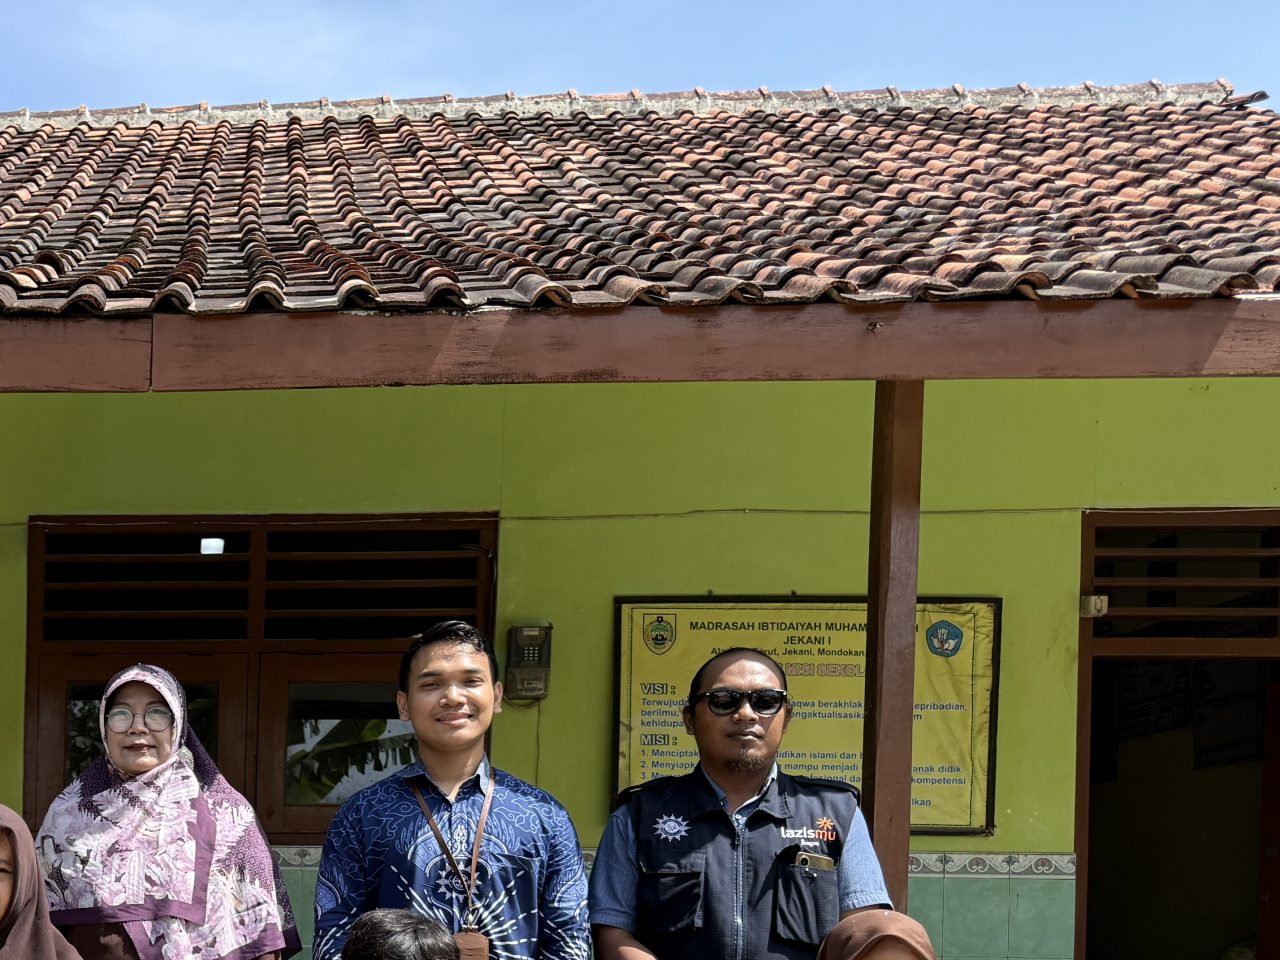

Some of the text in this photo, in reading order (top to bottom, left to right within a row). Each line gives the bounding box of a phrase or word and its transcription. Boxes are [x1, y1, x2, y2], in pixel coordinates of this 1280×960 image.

[689, 621, 867, 632] MADRASAH IBTIDAIYAH MUHAM
[783, 636, 825, 645] JEKANI
[782, 647, 815, 657] Jekani,
[817, 663, 866, 677] SEKOL
[640, 683, 668, 695] VISI
[818, 700, 862, 709] berakhlak
[914, 703, 967, 711] epribadian,
[640, 709, 680, 718] berilmu,
[640, 720, 685, 728] kehidupa
[640, 734, 670, 746] MISI
[651, 749, 700, 758] Menciptak
[839, 752, 857, 760] dan
[651, 761, 696, 770] Menyiapk
[784, 764, 859, 772] mampu menjadi
[780, 826, 836, 841] lazismu
